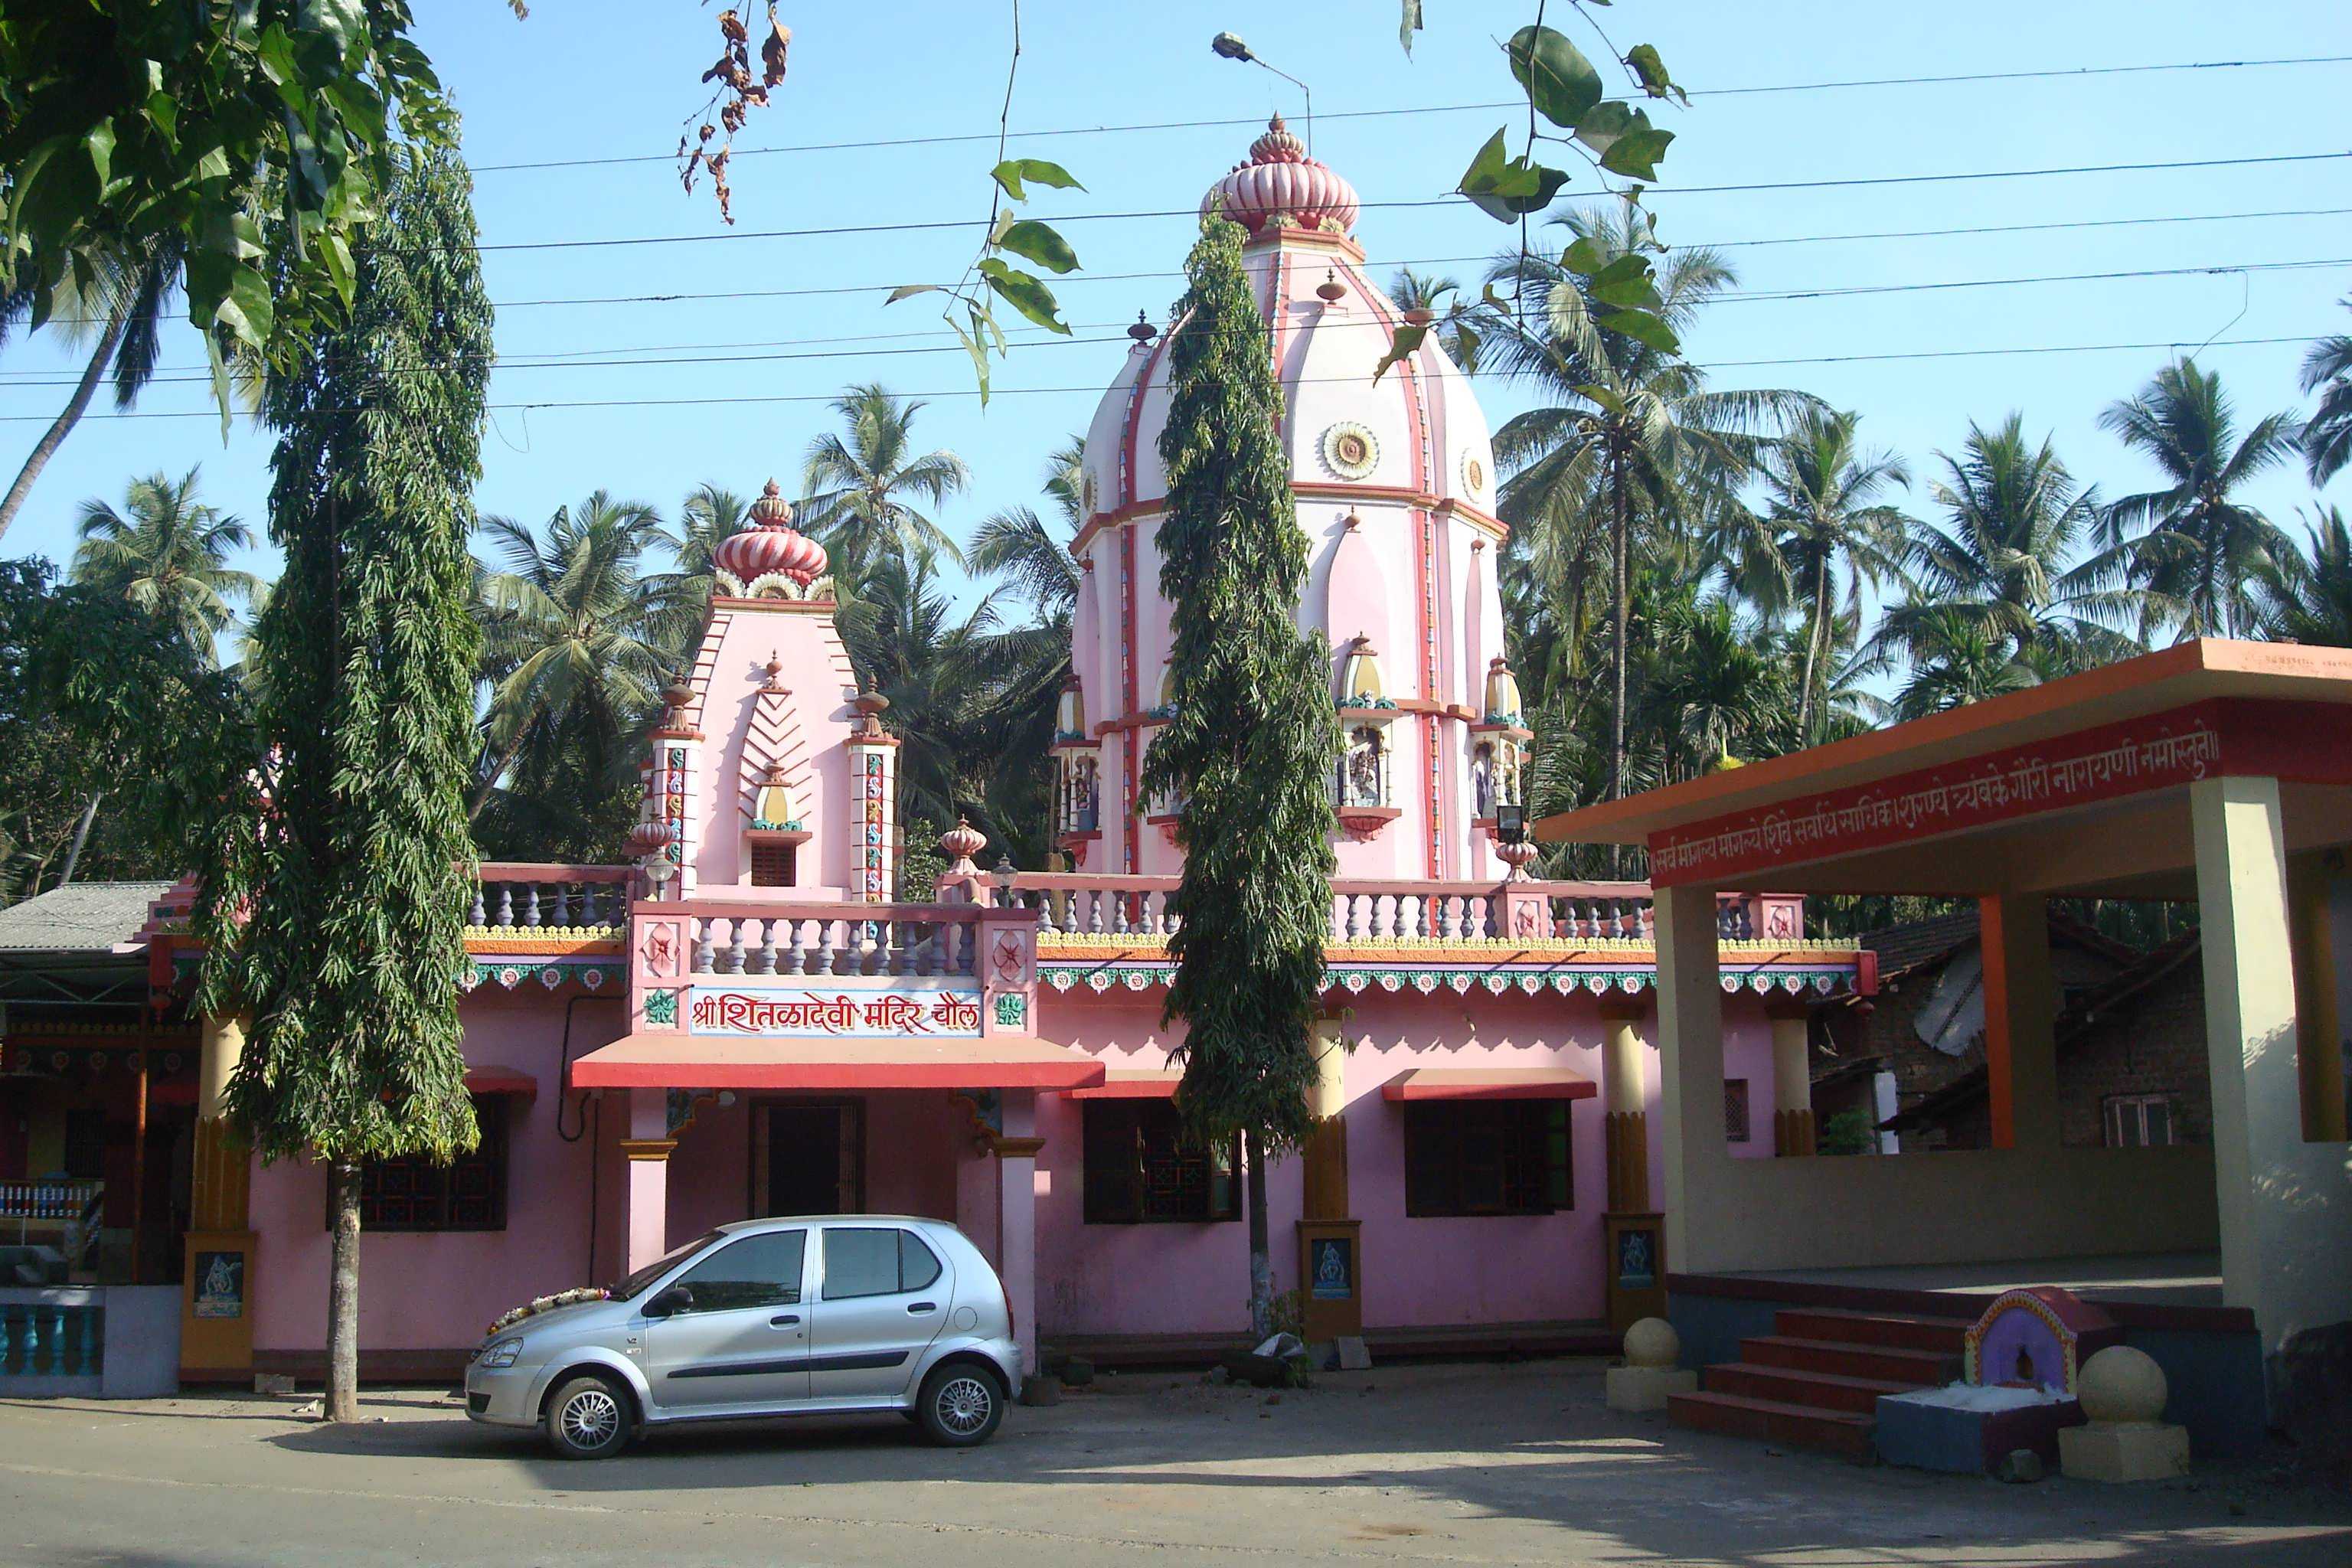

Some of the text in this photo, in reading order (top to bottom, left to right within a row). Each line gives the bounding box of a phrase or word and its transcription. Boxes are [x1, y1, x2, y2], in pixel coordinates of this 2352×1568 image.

[692, 991, 979, 1034] श्री शितळादेवी मंदिर चौल
